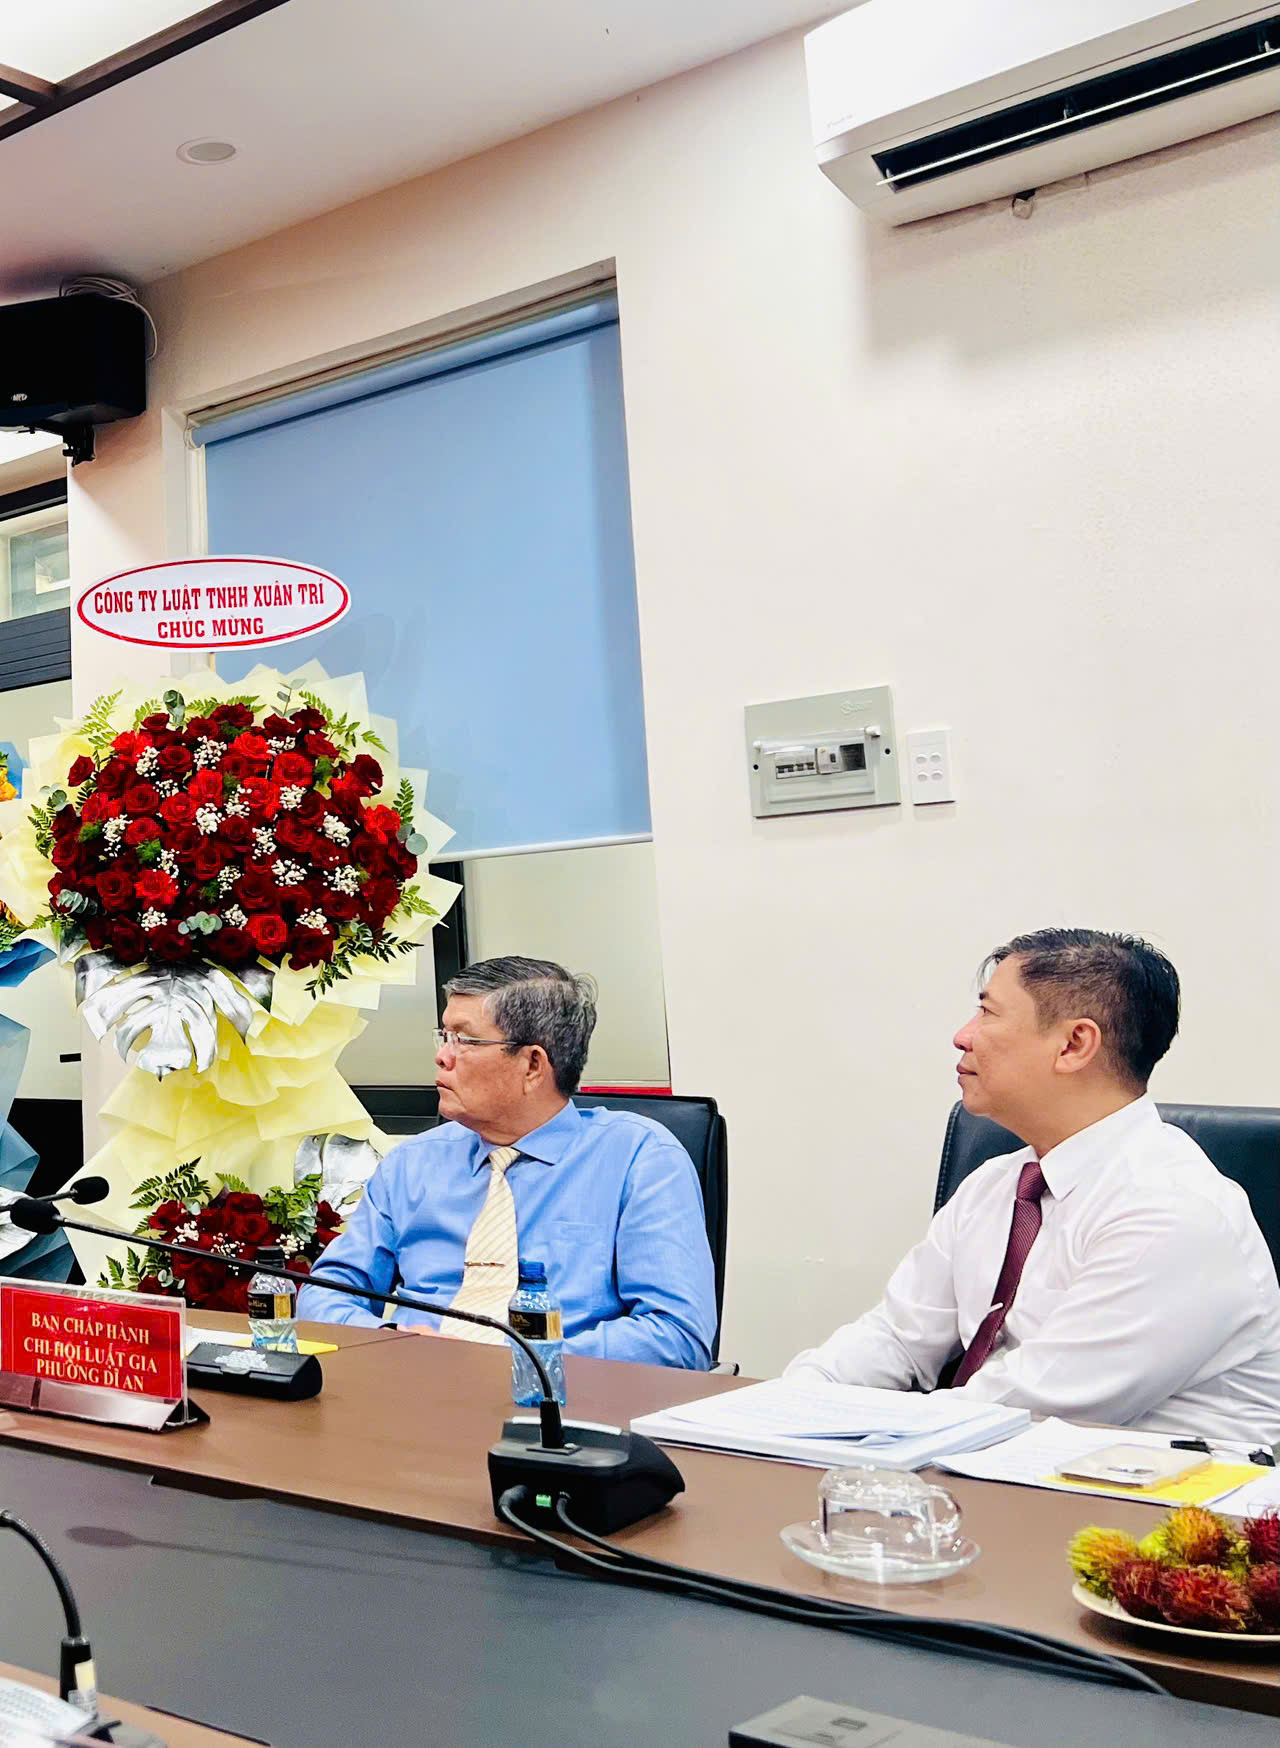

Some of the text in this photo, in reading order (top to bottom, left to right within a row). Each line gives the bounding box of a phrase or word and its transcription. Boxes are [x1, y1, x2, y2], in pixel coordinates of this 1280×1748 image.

[94, 578, 325, 615] CÔNG TY LUẬT TNHH XUÂN TRÍ
[157, 615, 205, 639] CHÚC
[32, 1312, 60, 1330] BAN
[106, 1321, 149, 1345] HÀNH
[24, 1336, 50, 1355] CHI
[129, 1354, 157, 1373] GIA
[123, 1375, 144, 1391] AN
